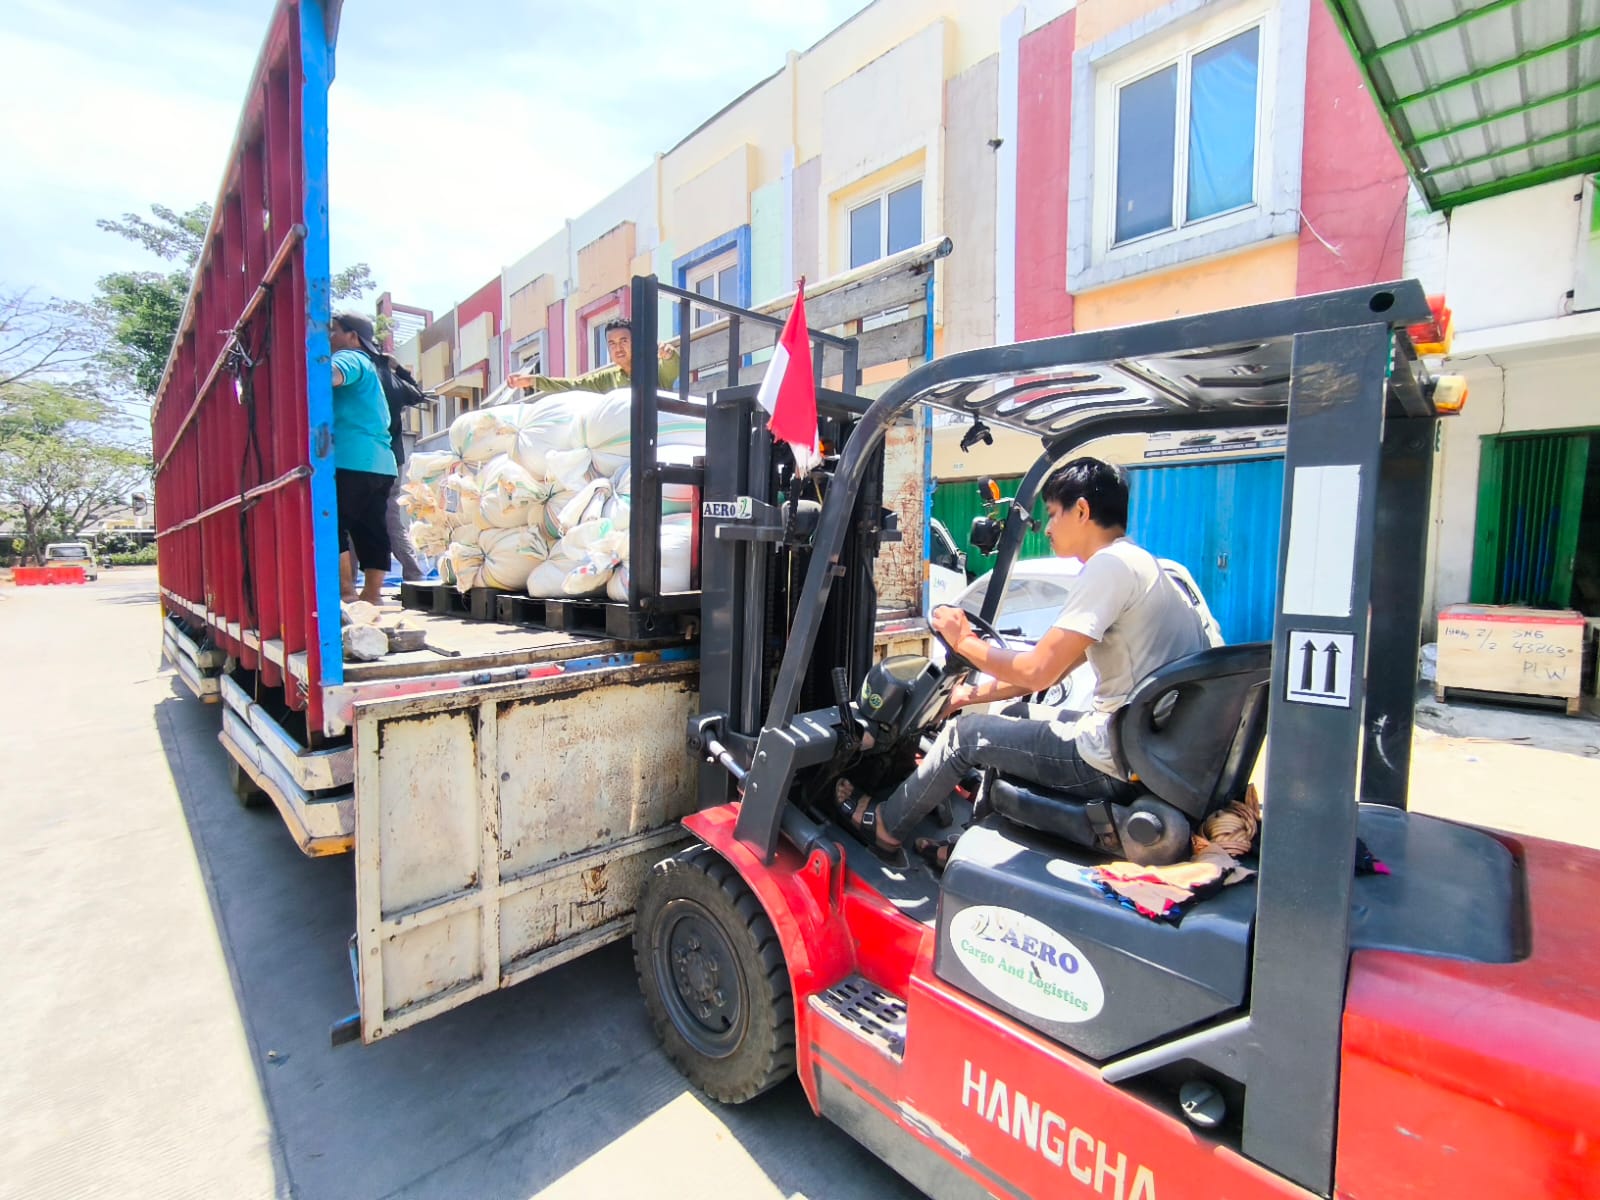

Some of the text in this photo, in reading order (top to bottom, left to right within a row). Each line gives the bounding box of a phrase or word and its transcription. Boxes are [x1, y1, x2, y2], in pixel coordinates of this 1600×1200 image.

[703, 503, 736, 517] AERO
[960, 938, 1089, 1012] Cargo And Logistics
[1000, 927, 1080, 975] AERO
[961, 1058, 1157, 1200] HANGCHA
